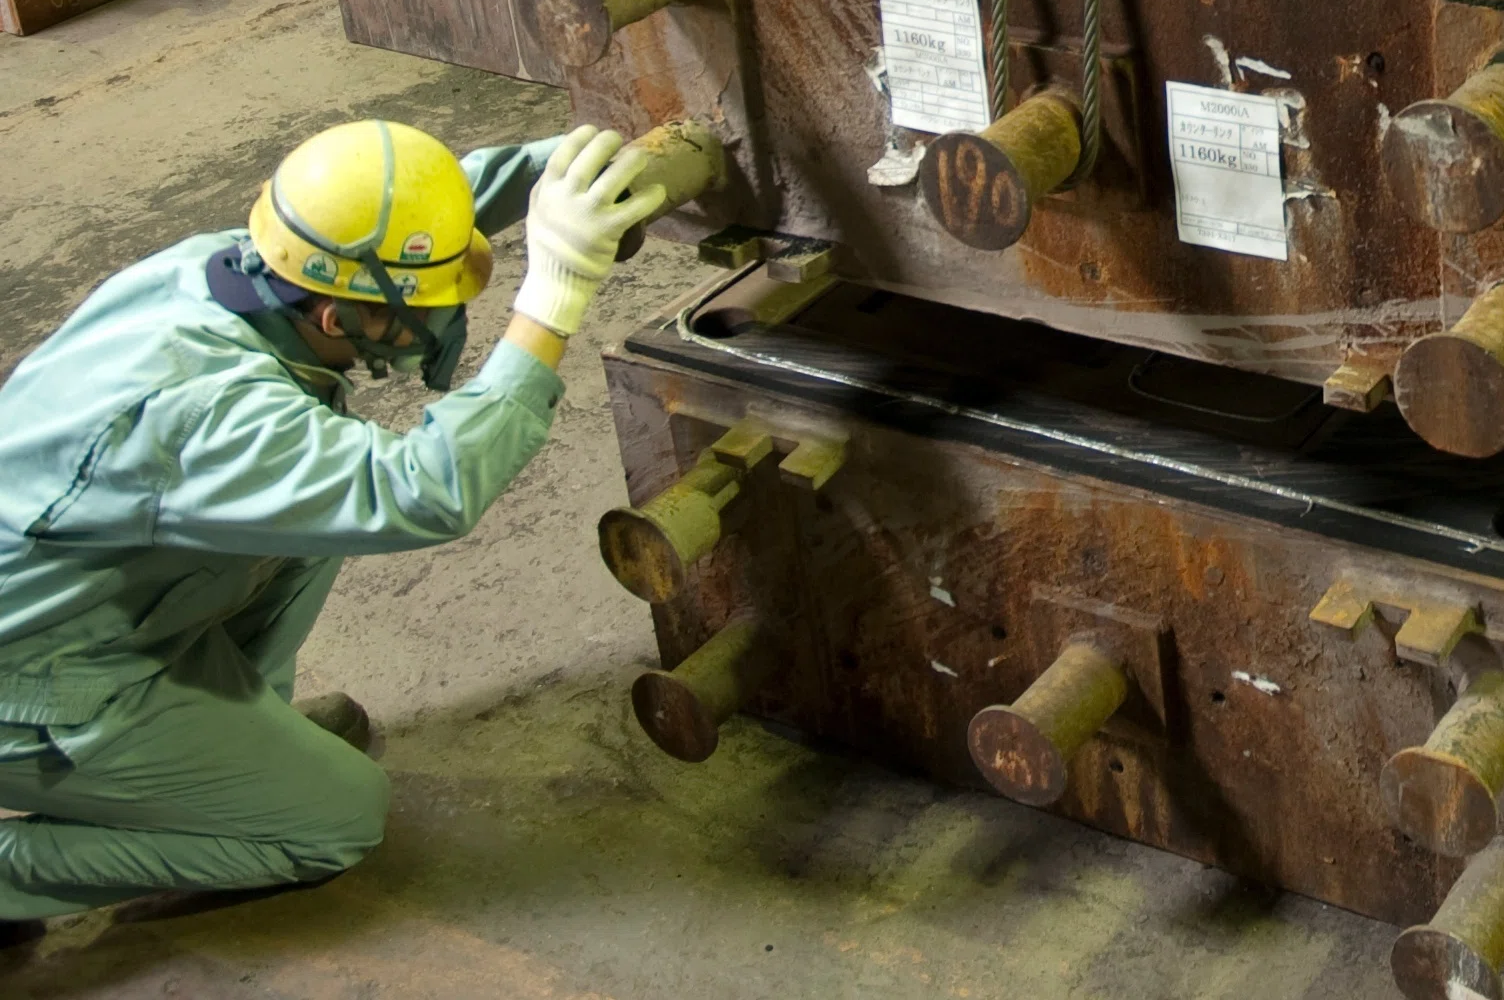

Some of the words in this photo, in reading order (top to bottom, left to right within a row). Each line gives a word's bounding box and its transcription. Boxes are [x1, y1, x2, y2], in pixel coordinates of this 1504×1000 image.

[894, 29, 946, 53] 1160kg
[1200, 101, 1250, 118] M2000iA
[1179, 143, 1237, 168] 1160kg
